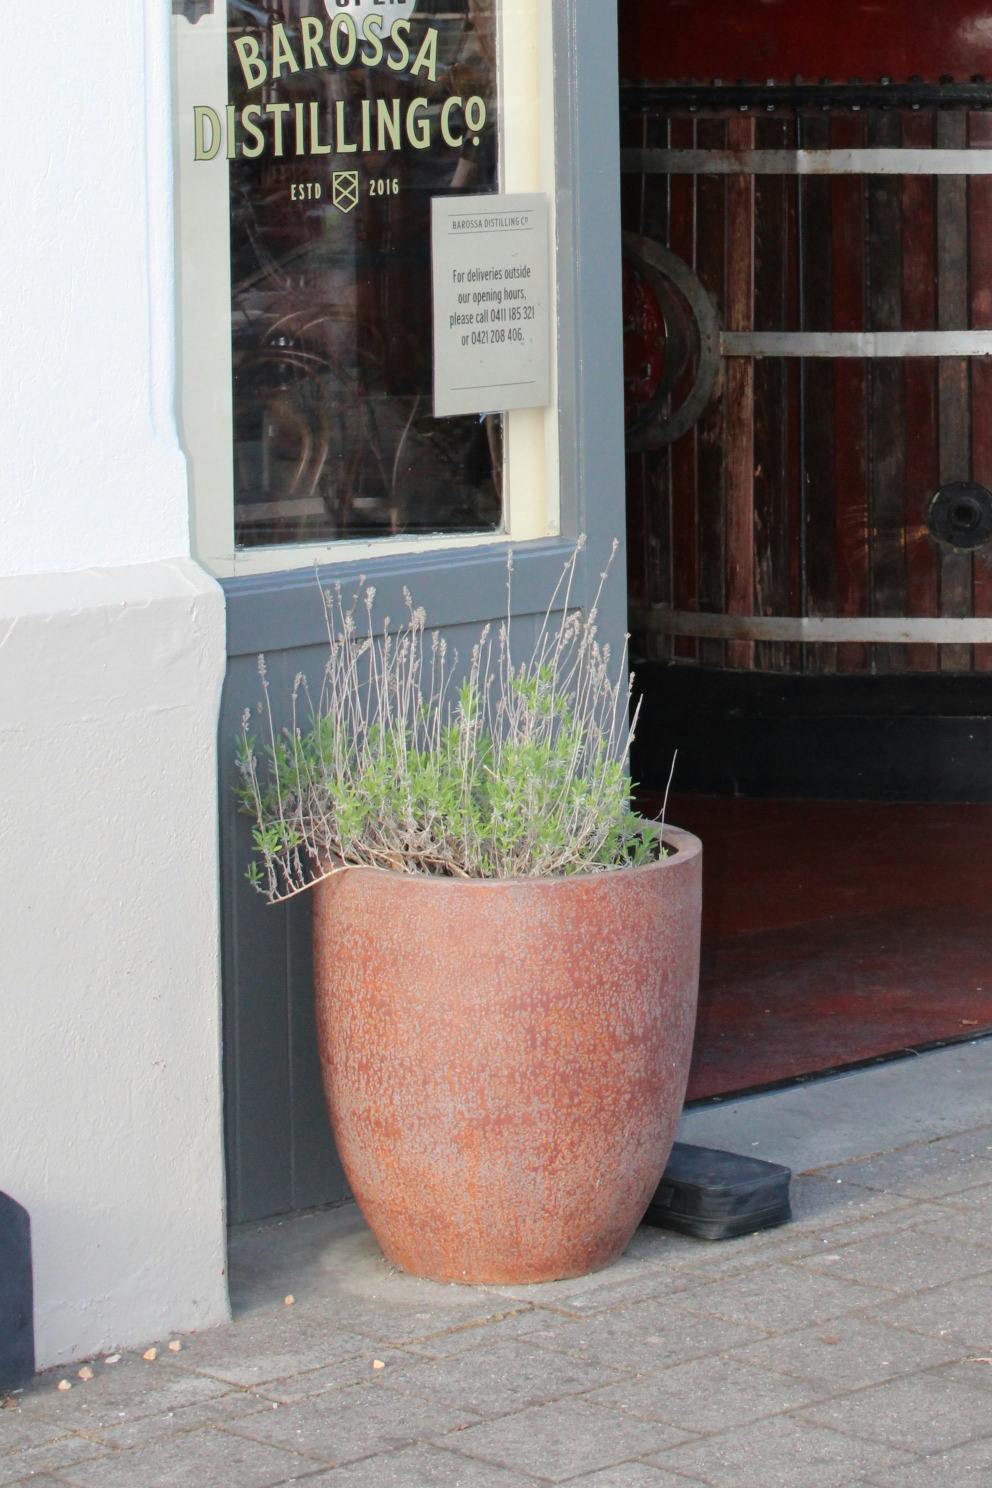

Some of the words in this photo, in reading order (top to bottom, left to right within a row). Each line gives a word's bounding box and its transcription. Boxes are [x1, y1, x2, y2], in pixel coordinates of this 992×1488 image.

[233, 12, 439, 90] BAROSSA
[193, 97, 431, 161] DISTILLING
[290, 183, 321, 200] ESTD
[369, 179, 399, 196] 2016
[452, 219, 482, 229] BAROSSA
[484, 217, 520, 228] DISTILLING
[453, 269, 465, 283] For
[467, 267, 502, 282] deliveries
[505, 265, 531, 279] outside
[458, 292, 471, 304] our
[472, 288, 502, 305] opening
[504, 287, 527, 301] hours,
[449, 312, 473, 328] please
[475, 309, 489, 323] call
[490, 308, 507, 322] 0411
[523, 305, 535, 320] 321
[461, 335, 469, 346] or
[471, 331, 489, 344] 0421
[490, 329, 505, 343] 208
